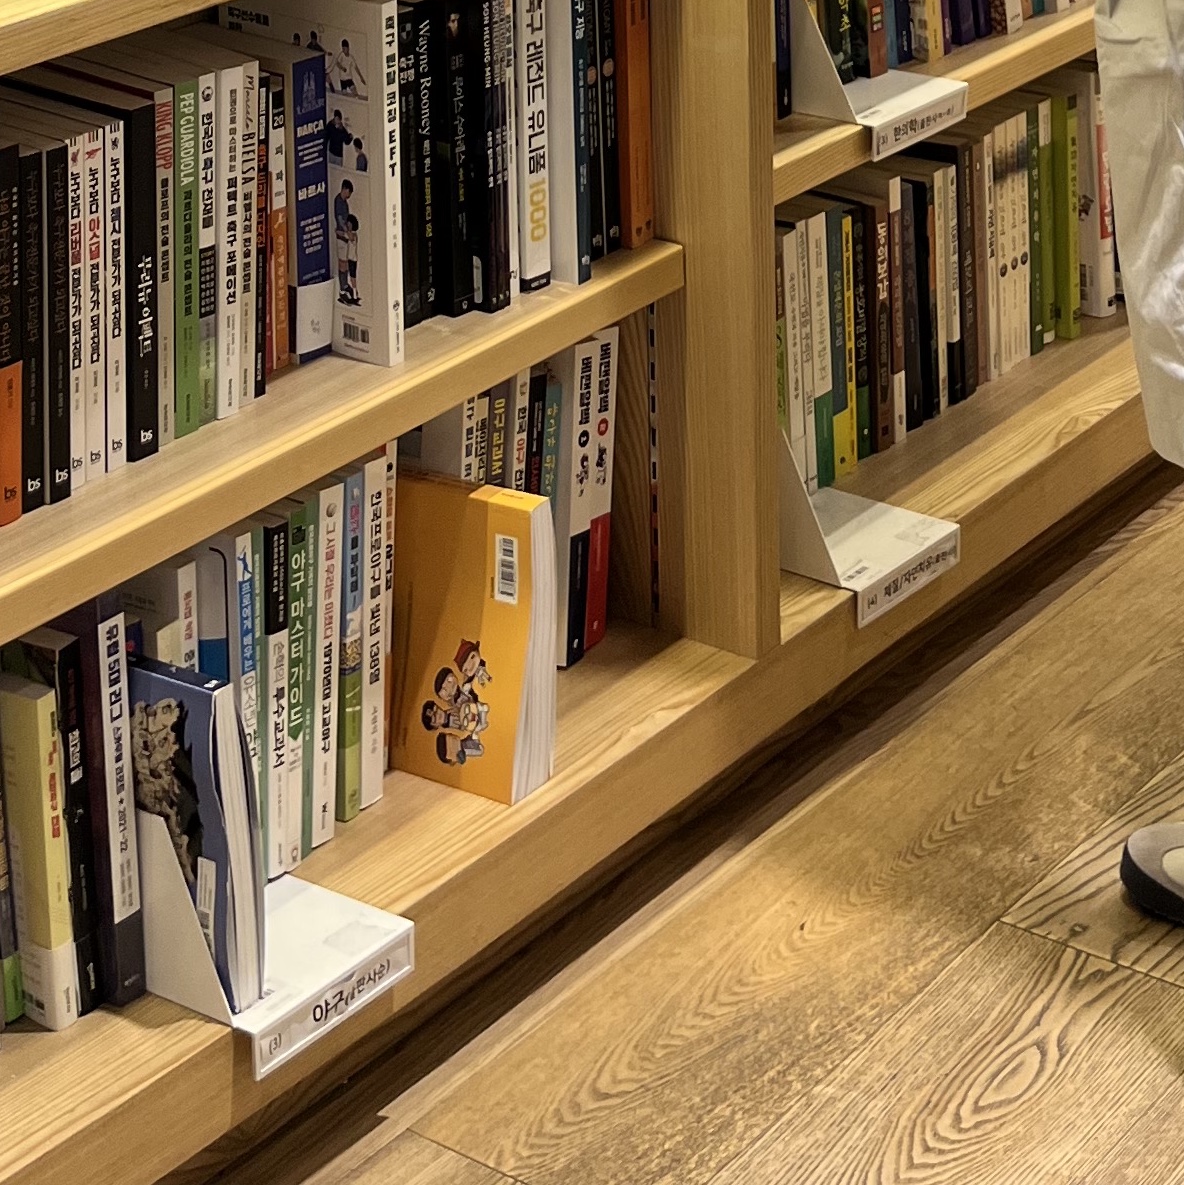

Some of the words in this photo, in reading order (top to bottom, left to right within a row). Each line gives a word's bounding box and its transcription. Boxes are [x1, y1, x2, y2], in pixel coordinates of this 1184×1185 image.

[416, 20, 430, 73] Wayne
[575, 16, 585, 40] 지능
[483, 27, 491, 88] HEUNG-MIN
[526, 41, 545, 106] 레전드
[156, 100, 172, 131] KING
[180, 93, 195, 113] PEP
[419, 77, 432, 135] Rooney
[157, 134, 173, 169] KLOPP
[180, 116, 195, 186] GUARDIOLA
[202, 112, 213, 153] 한국의
[528, 109, 546, 174] 유니폼
[110, 157, 120, 204] 누구보다
[202, 157, 213, 184] 축구
[242, 133, 255, 185] BIELSA
[71, 172, 81, 219] 누구보다
[89, 167, 99, 214] 누구보다
[202, 188, 213, 229] 천재들
[529, 178, 547, 242] 1000
[71, 221, 81, 265] 리버풀
[227, 221, 236, 246] 축구
[111, 238, 121, 285] 전문가가
[138, 255, 152, 304] 무리뉴
[226, 251, 236, 304] 포메이션
[876, 221, 889, 302] 동의보감
[72, 268, 82, 316] 전문가가
[90, 263, 100, 311] 전문가가
[517, 407, 526, 434] 한국
[516, 438, 525, 464] 야구
[325, 538, 335, 560] 시절
[369, 491, 382, 599] 한국프로야구를
[290, 549, 306, 592] 야구
[324, 564, 335, 600] 우리는
[106, 624, 121, 658] 유럽
[290, 597, 304, 658] 마스터
[324, 603, 334, 638] 미쳤다
[369, 603, 381, 635] 빛낸
[108, 662, 121, 687] 5대
[322, 642, 333, 700] 1970년대
[369, 640, 380, 684] 138명
[110, 688, 122, 724] 리그
[289, 663, 304, 725] 가이드
[273, 686, 285, 769] 투수교과서
[322, 704, 331, 753] 고교야구
[118, 807, 128, 853] 2021-22
[268, 1032, 283, 1055] (3)
